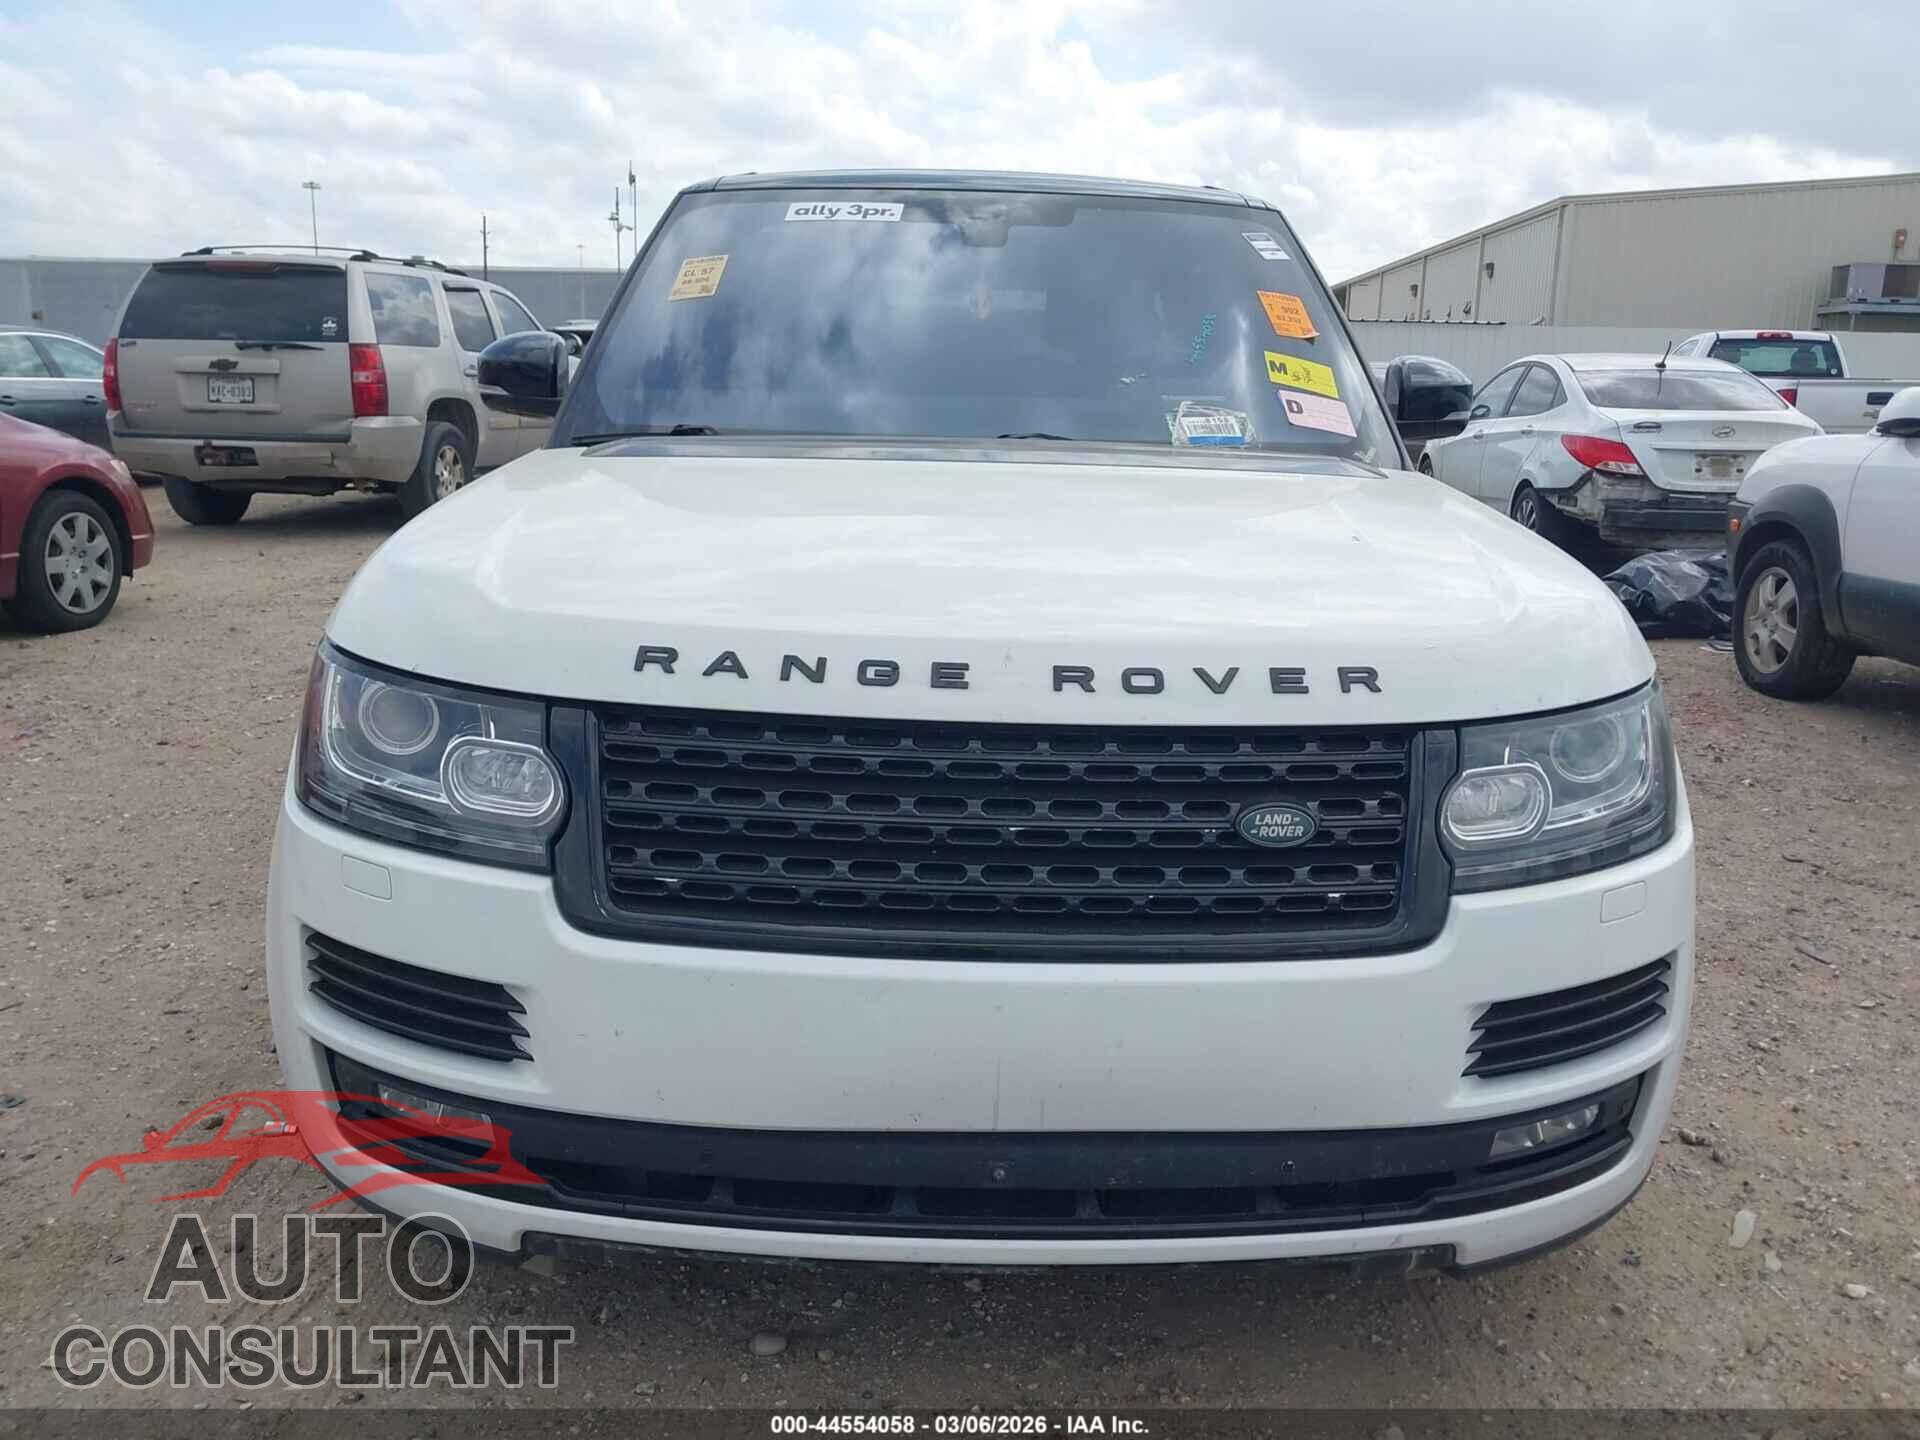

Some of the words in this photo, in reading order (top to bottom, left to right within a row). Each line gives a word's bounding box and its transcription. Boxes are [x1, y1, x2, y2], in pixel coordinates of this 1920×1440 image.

[794, 204, 842, 219] ally
[846, 204, 896, 219] 3pr.
[1268, 359, 1288, 376] M
[1285, 398, 1304, 415] D
[633, 645, 971, 690] RANGE
[1052, 664, 1383, 696] ROVER
[1255, 813, 1292, 825] LAND
[1259, 825, 1304, 837] ROVER
